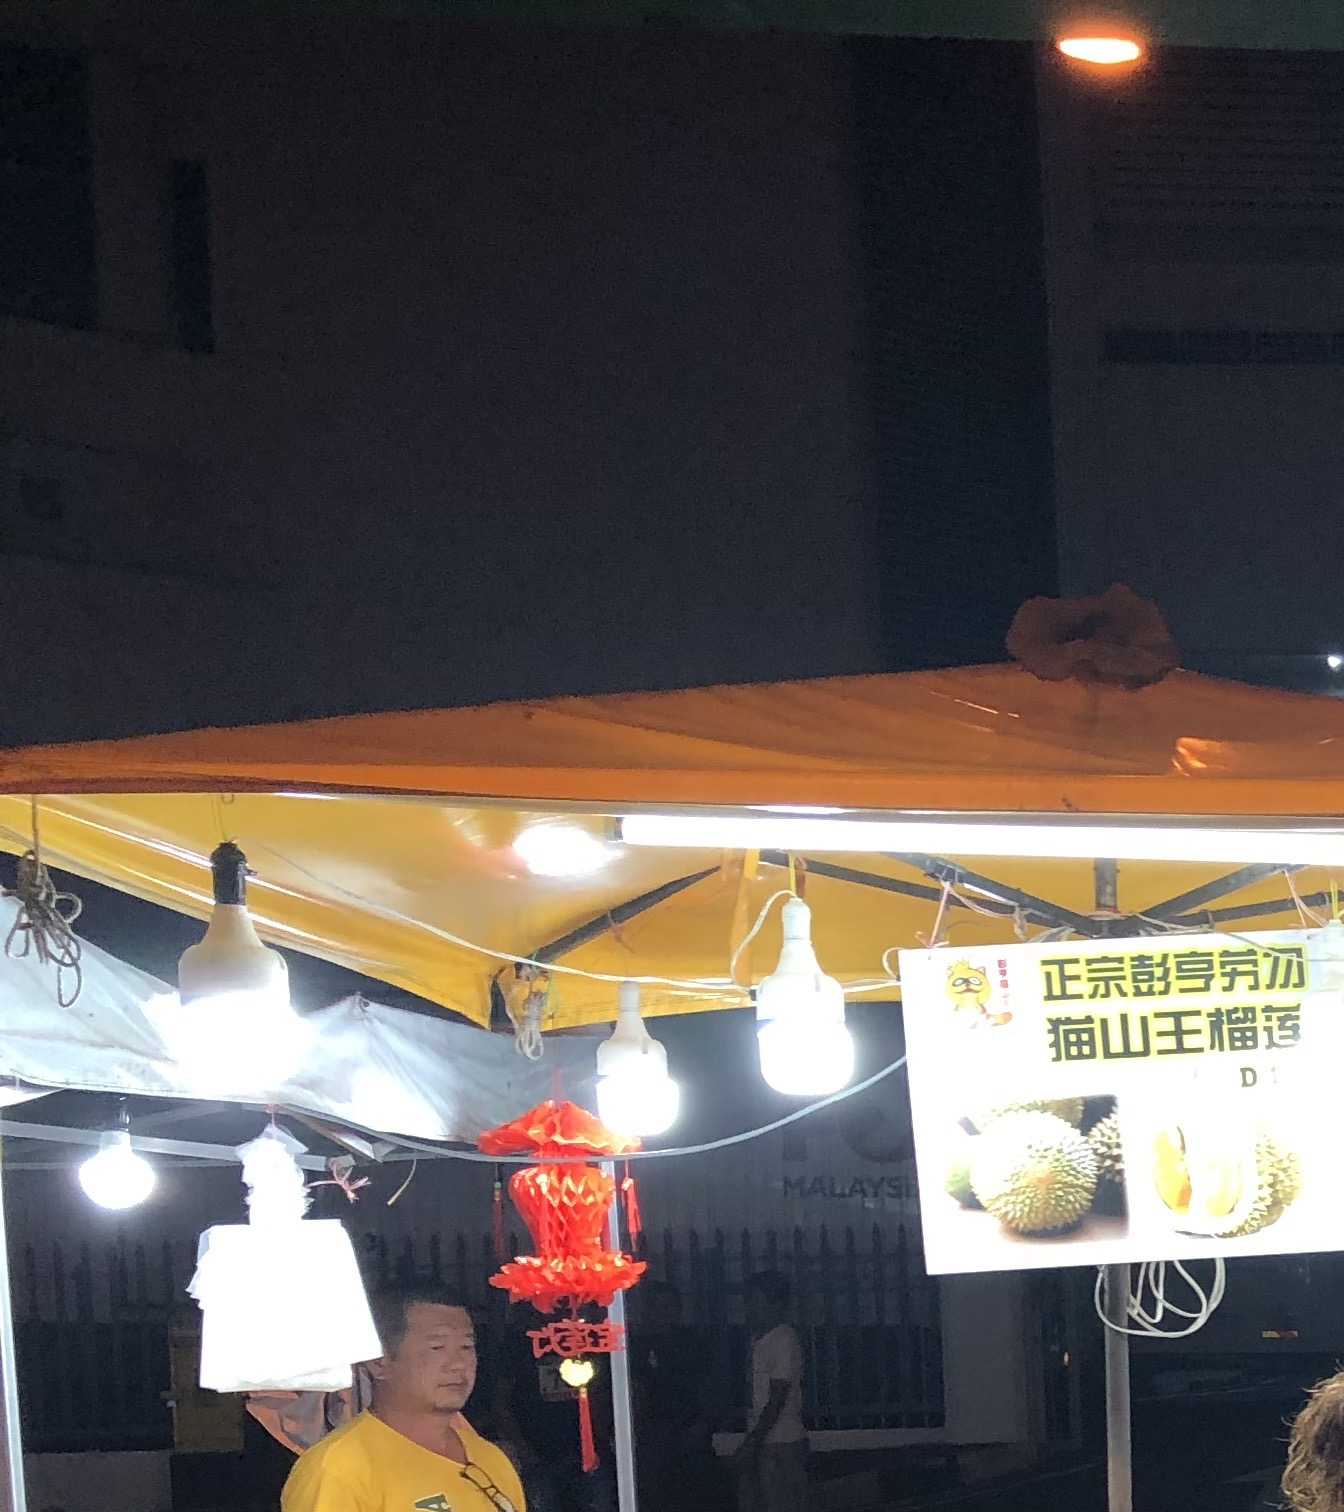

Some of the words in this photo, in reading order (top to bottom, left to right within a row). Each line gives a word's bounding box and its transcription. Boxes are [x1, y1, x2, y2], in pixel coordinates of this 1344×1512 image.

[1041, 946, 1307, 1001] 正宗彭亨劳勿
[1047, 1004, 1302, 1062] 猫山王榴莲
[783, 1174, 917, 1200] MALAYSI
